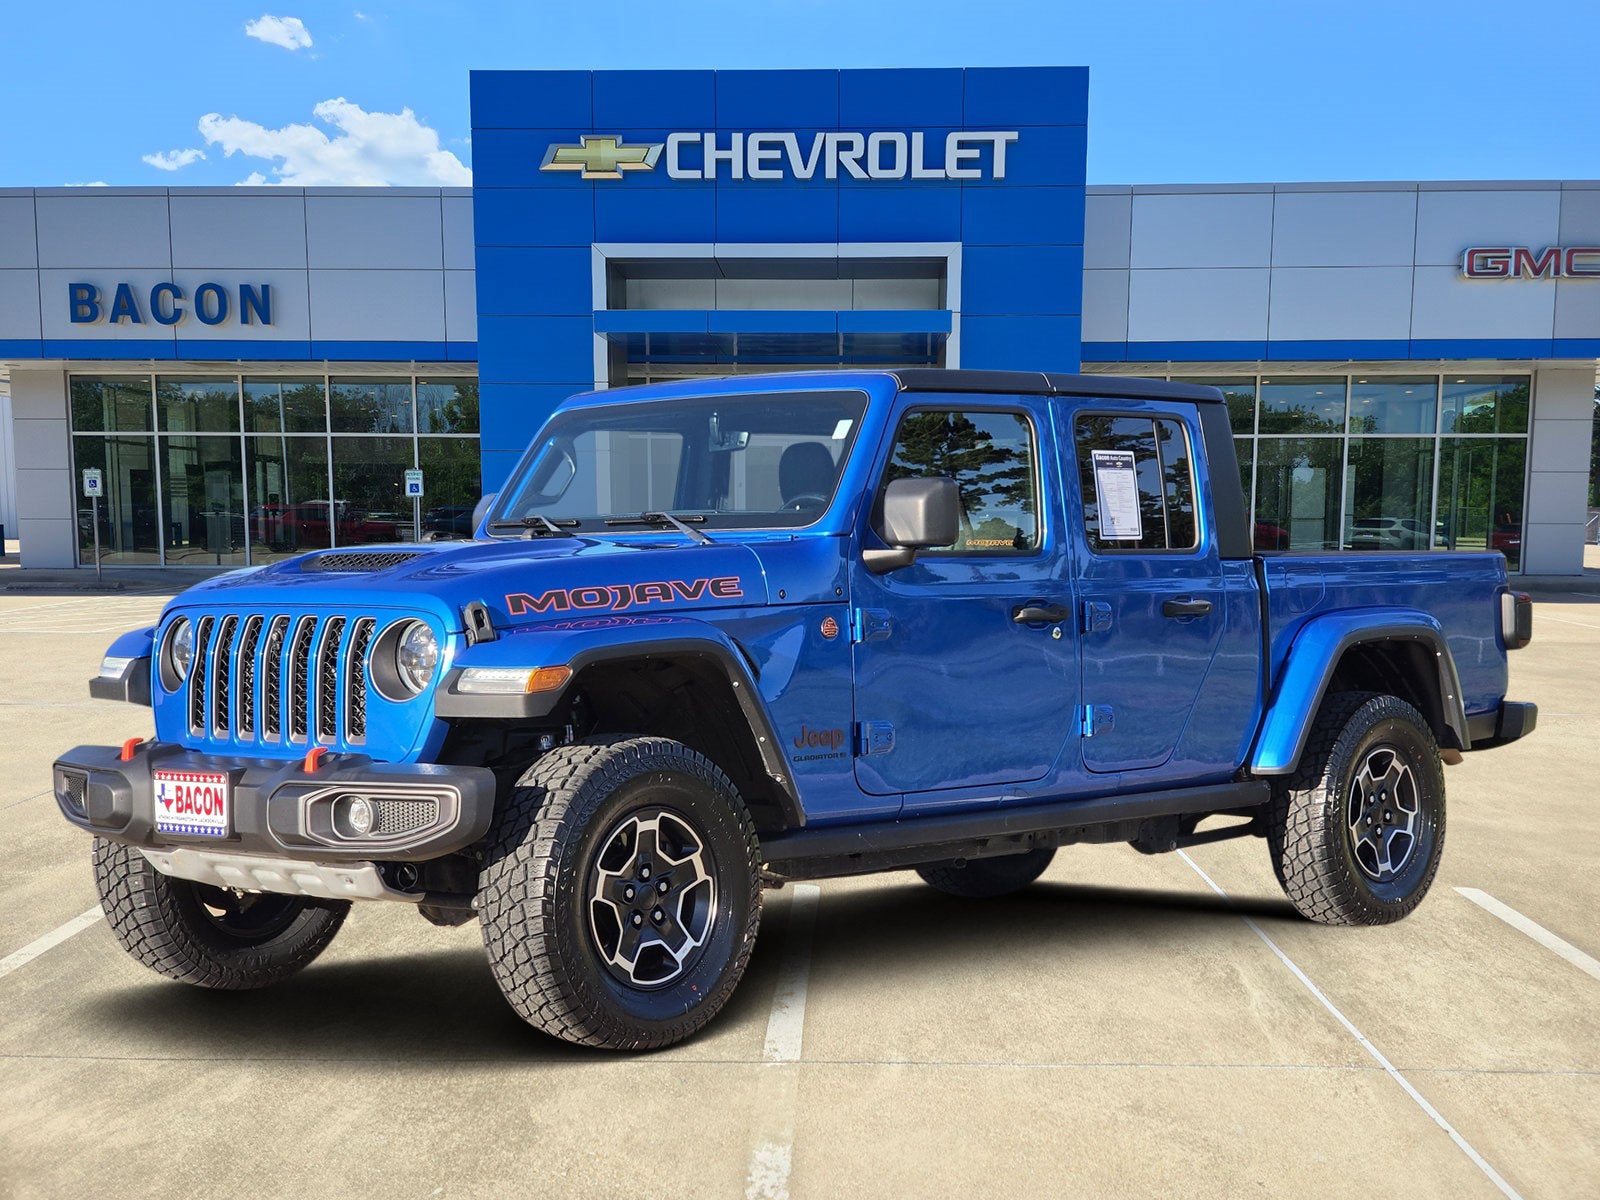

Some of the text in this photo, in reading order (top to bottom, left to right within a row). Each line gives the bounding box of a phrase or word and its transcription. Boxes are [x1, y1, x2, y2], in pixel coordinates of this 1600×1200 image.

[666, 131, 1019, 180] CHEVROLET
[1463, 247, 1600, 278] GMC
[69, 282, 272, 326] BACON
[506, 577, 743, 615] MOJAVE
[794, 724, 844, 751] Jeep
[793, 752, 839, 762] GLADIATOR
[175, 785, 224, 816] BACON
